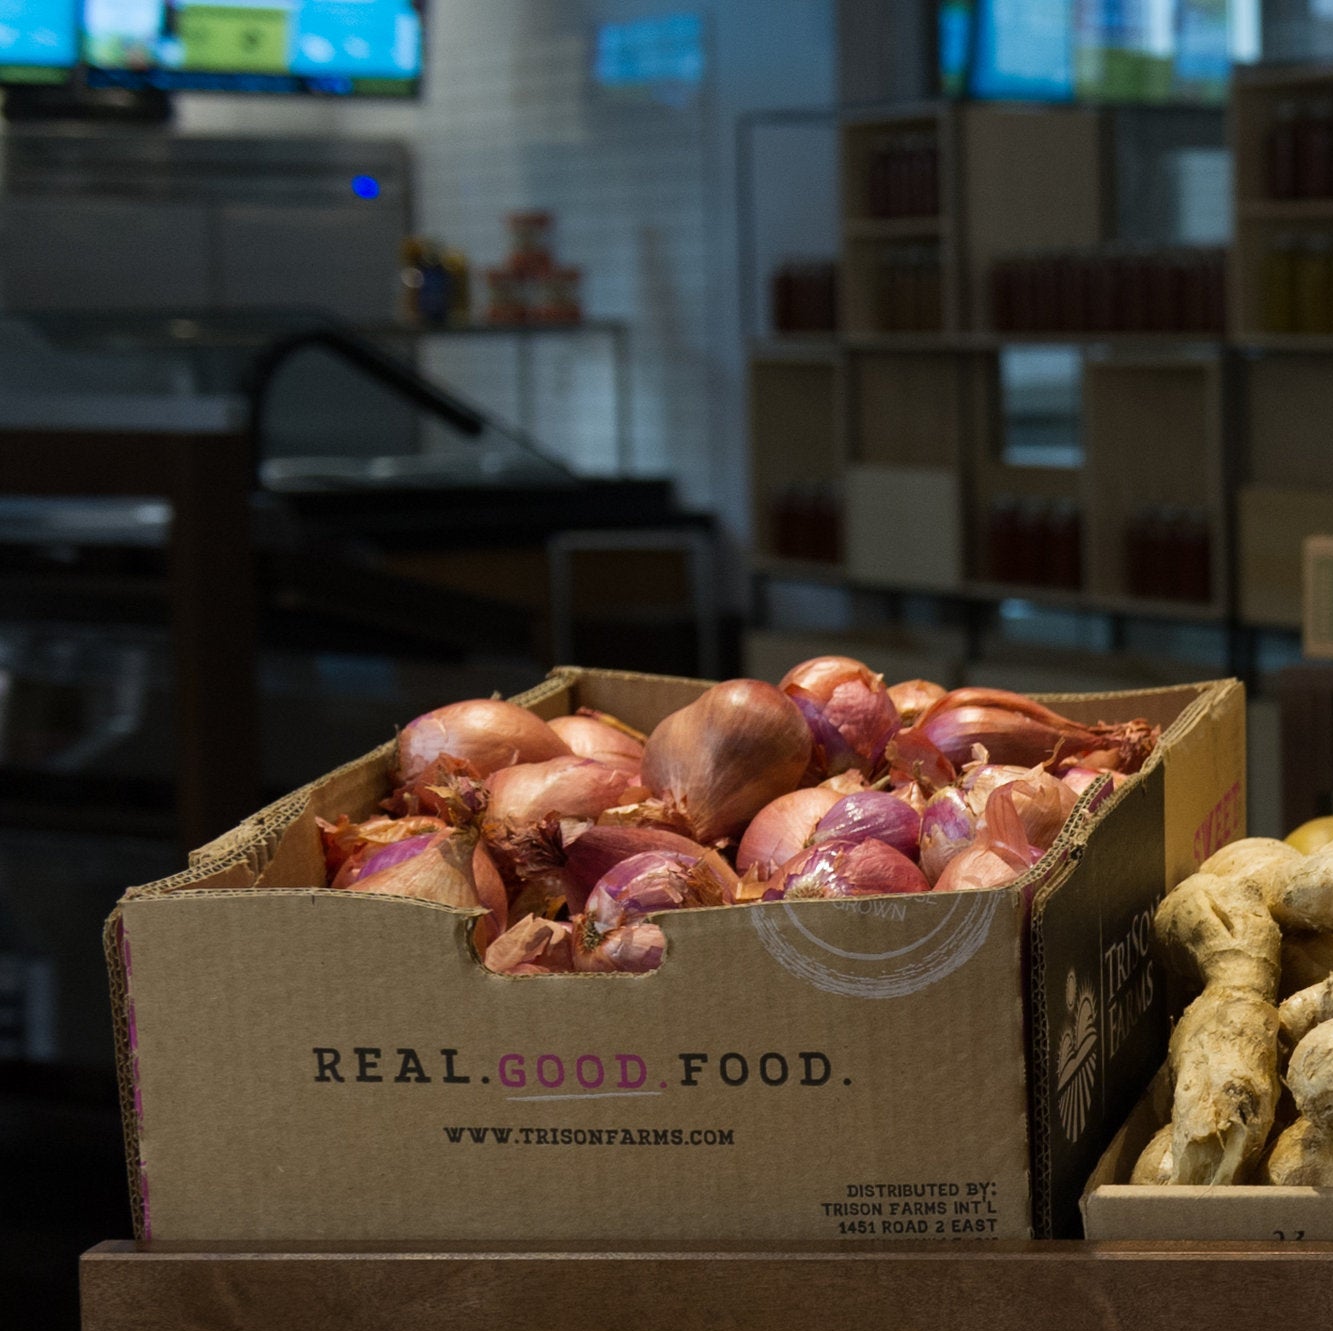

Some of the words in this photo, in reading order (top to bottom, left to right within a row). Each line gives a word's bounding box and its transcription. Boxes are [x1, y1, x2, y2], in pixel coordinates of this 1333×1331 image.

[444, 1127, 734, 1146] WWW.TRISONFARMS.COM
[847, 1183, 959, 1198] DISTRIBUTED
[821, 1203, 883, 1216] TRISON
[889, 1201, 947, 1215] FARMS
[882, 1220, 928, 1234] ROAD
[952, 1218, 997, 1233] EAST
